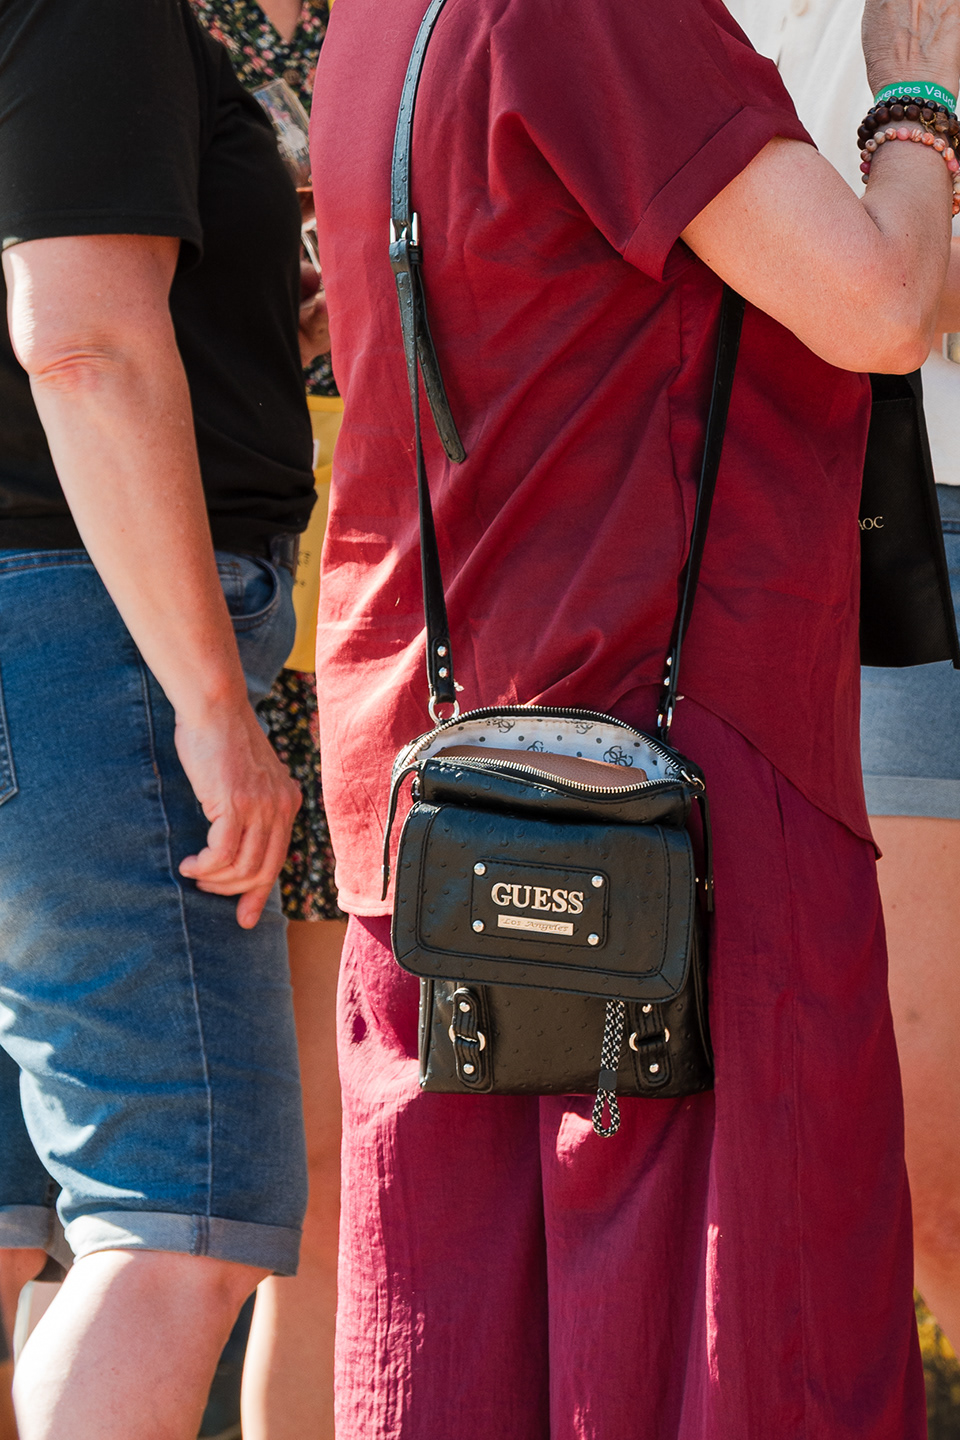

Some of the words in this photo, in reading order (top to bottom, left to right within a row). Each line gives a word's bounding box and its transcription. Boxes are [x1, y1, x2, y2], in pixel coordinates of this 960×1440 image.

[491, 882, 584, 914] GUESS
[502, 918, 521, 926] Los
[525, 921, 569, 932] Angeles
